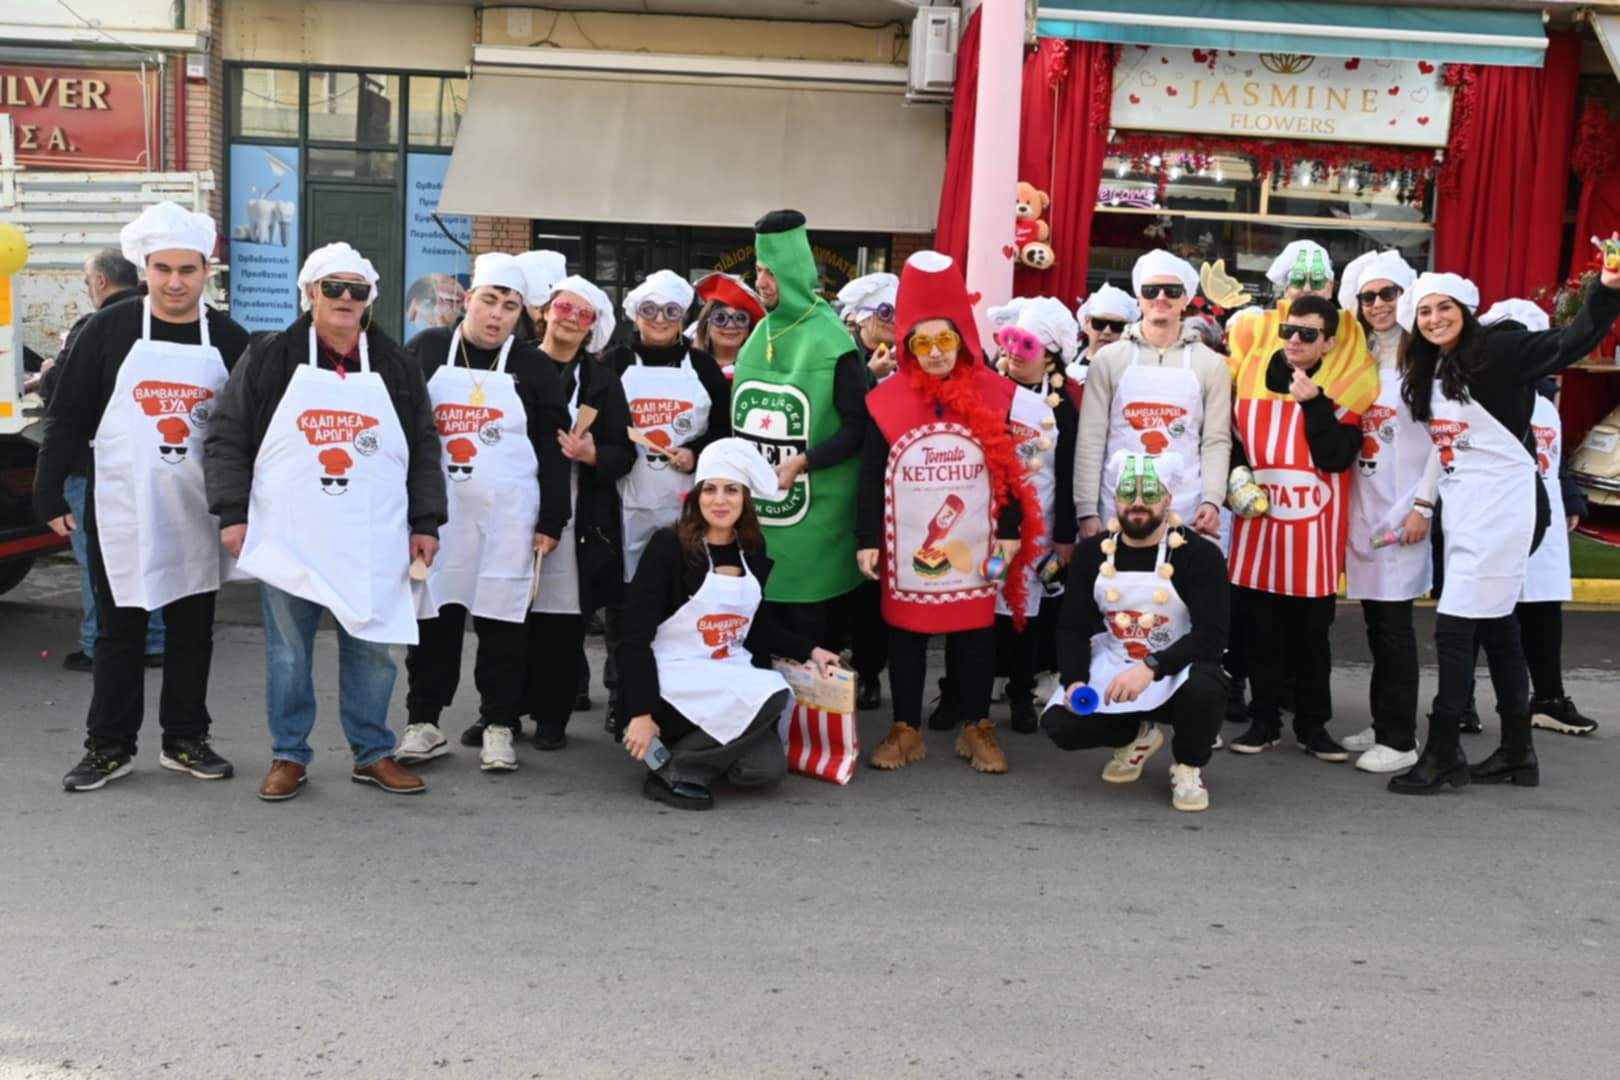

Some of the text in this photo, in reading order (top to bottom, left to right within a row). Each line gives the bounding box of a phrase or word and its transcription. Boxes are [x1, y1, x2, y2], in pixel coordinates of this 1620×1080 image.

[0, 75, 109, 110] LVER
[1188, 79, 1378, 113] JASMINE
[1230, 112, 1336, 134] FLOWERS
[921, 445, 966, 465] Tomato
[902, 463, 984, 482] KETCHUP
